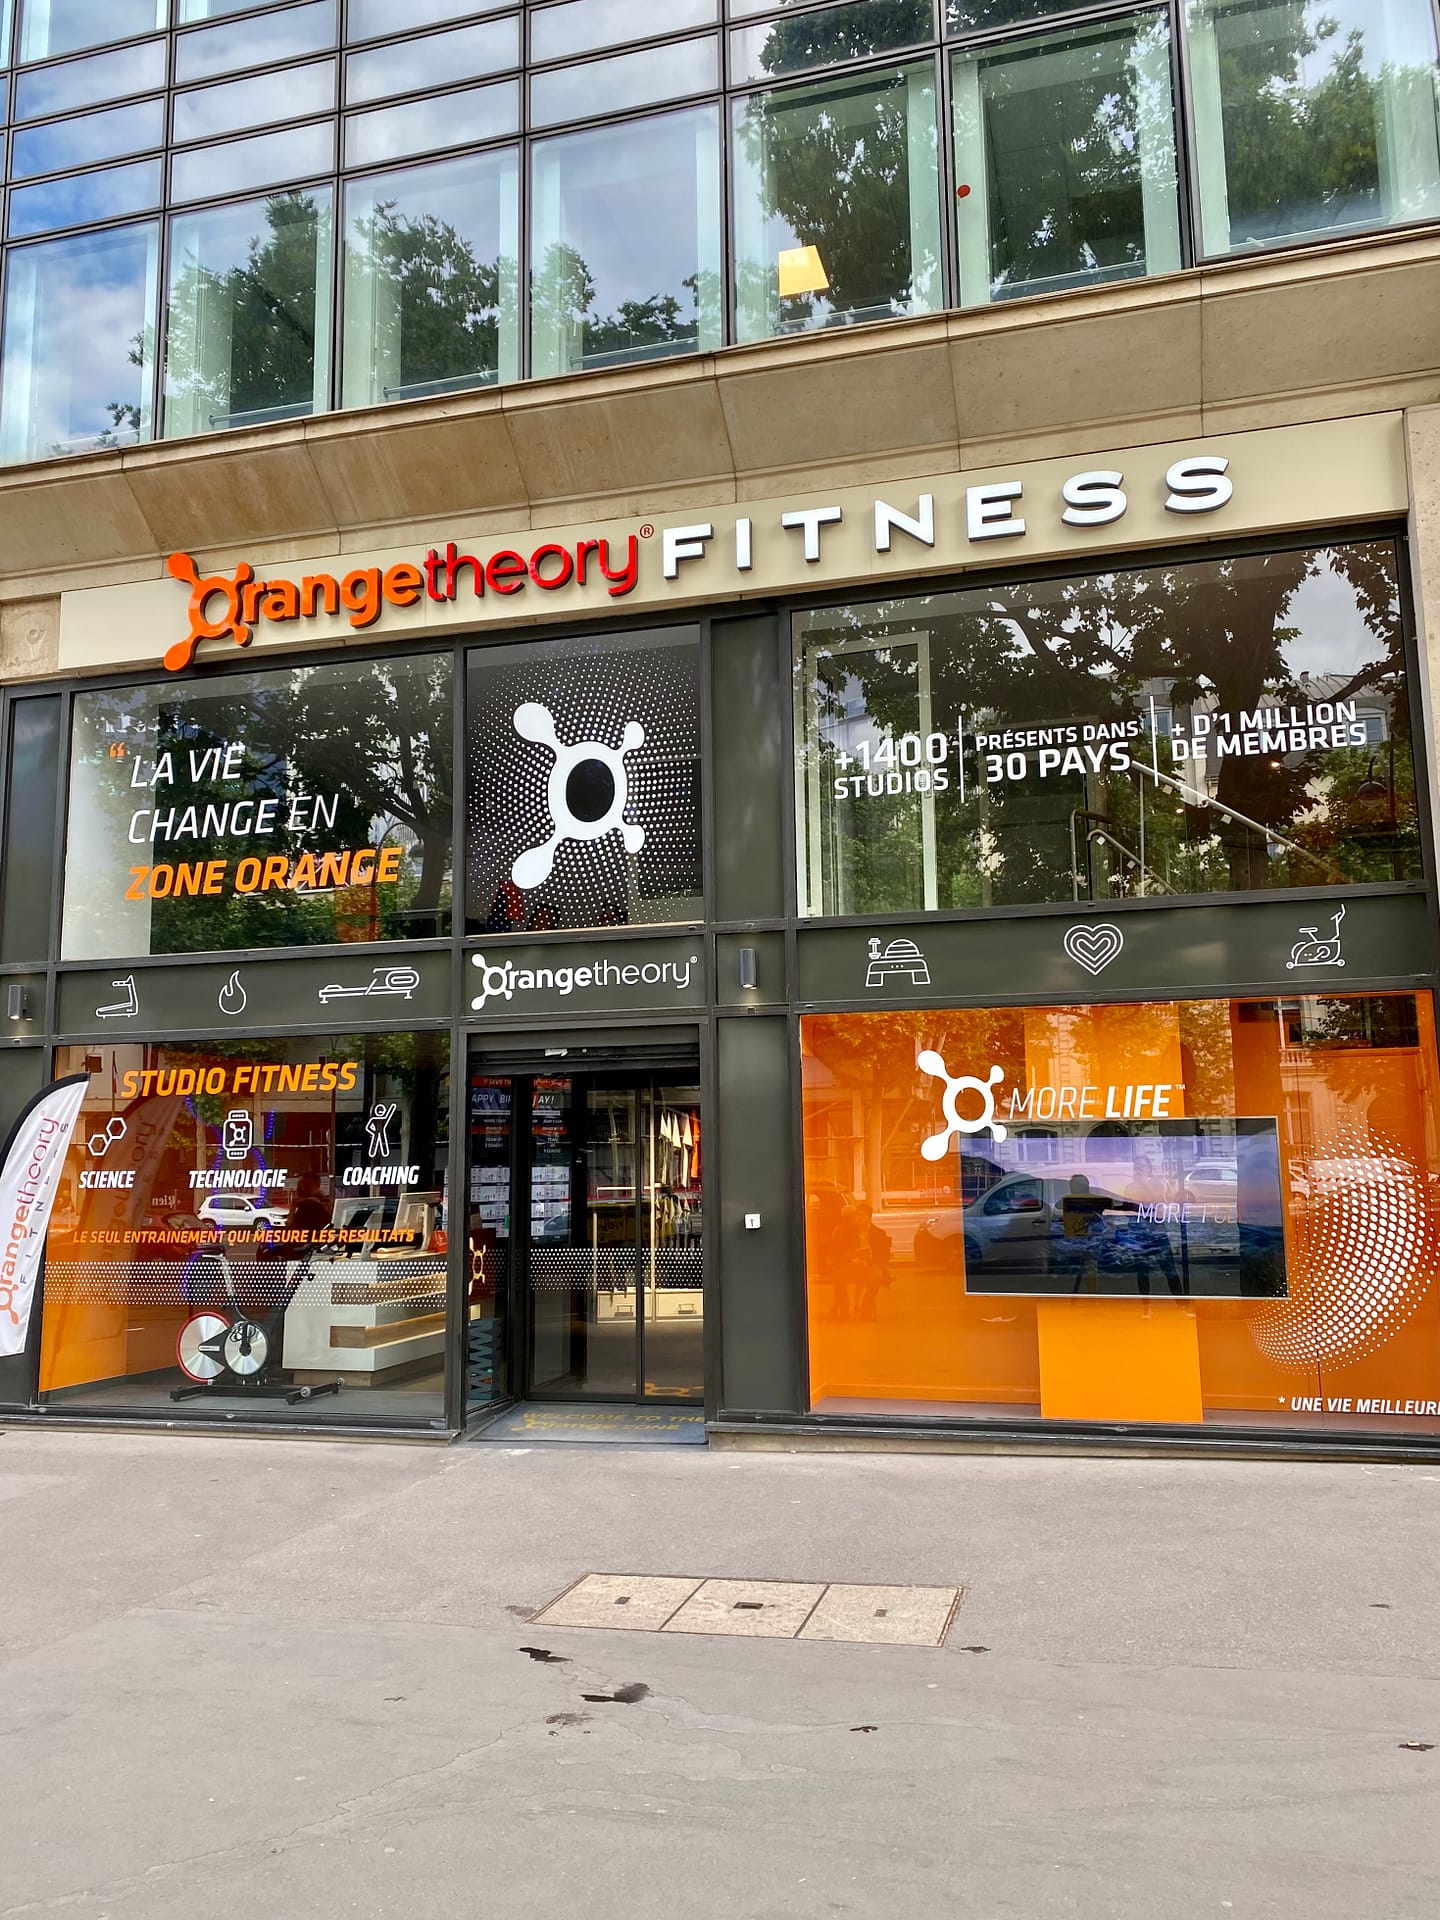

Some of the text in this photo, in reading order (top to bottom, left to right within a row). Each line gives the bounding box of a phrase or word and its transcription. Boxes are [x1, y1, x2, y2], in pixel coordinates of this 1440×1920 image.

[662, 455, 1233, 579] FITNESS
[1240, 700, 1357, 731] MILLION
[834, 732, 948, 771] +1400
[975, 720, 1139, 752] PRÉSENTS DANS
[1171, 722, 1367, 761] DE MEMBRES
[130, 752, 174, 788] LA
[189, 744, 246, 782] VIE
[985, 741, 1131, 783] 30 PAYS
[833, 767, 949, 800] STUDIOS
[128, 793, 340, 844] CHANGE EN
[125, 847, 403, 900] ZONE ORANGE
[121, 1062, 358, 1098] STUDIO FITNESS
[1009, 1086, 1098, 1119] MORE
[78, 1169, 136, 1189] SCIENCE
[188, 1168, 288, 1189] TECHNOLOGIE
[342, 1165, 420, 1186] COACHING
[1136, 1202, 1193, 1224] MORE
[73, 1228, 415, 1246] LE SEUL ENTRAINEMENT QUI MESURE LES RESULTATS
[1291, 1396, 1323, 1411] UNE
[1327, 1397, 1353, 1412] VIE
